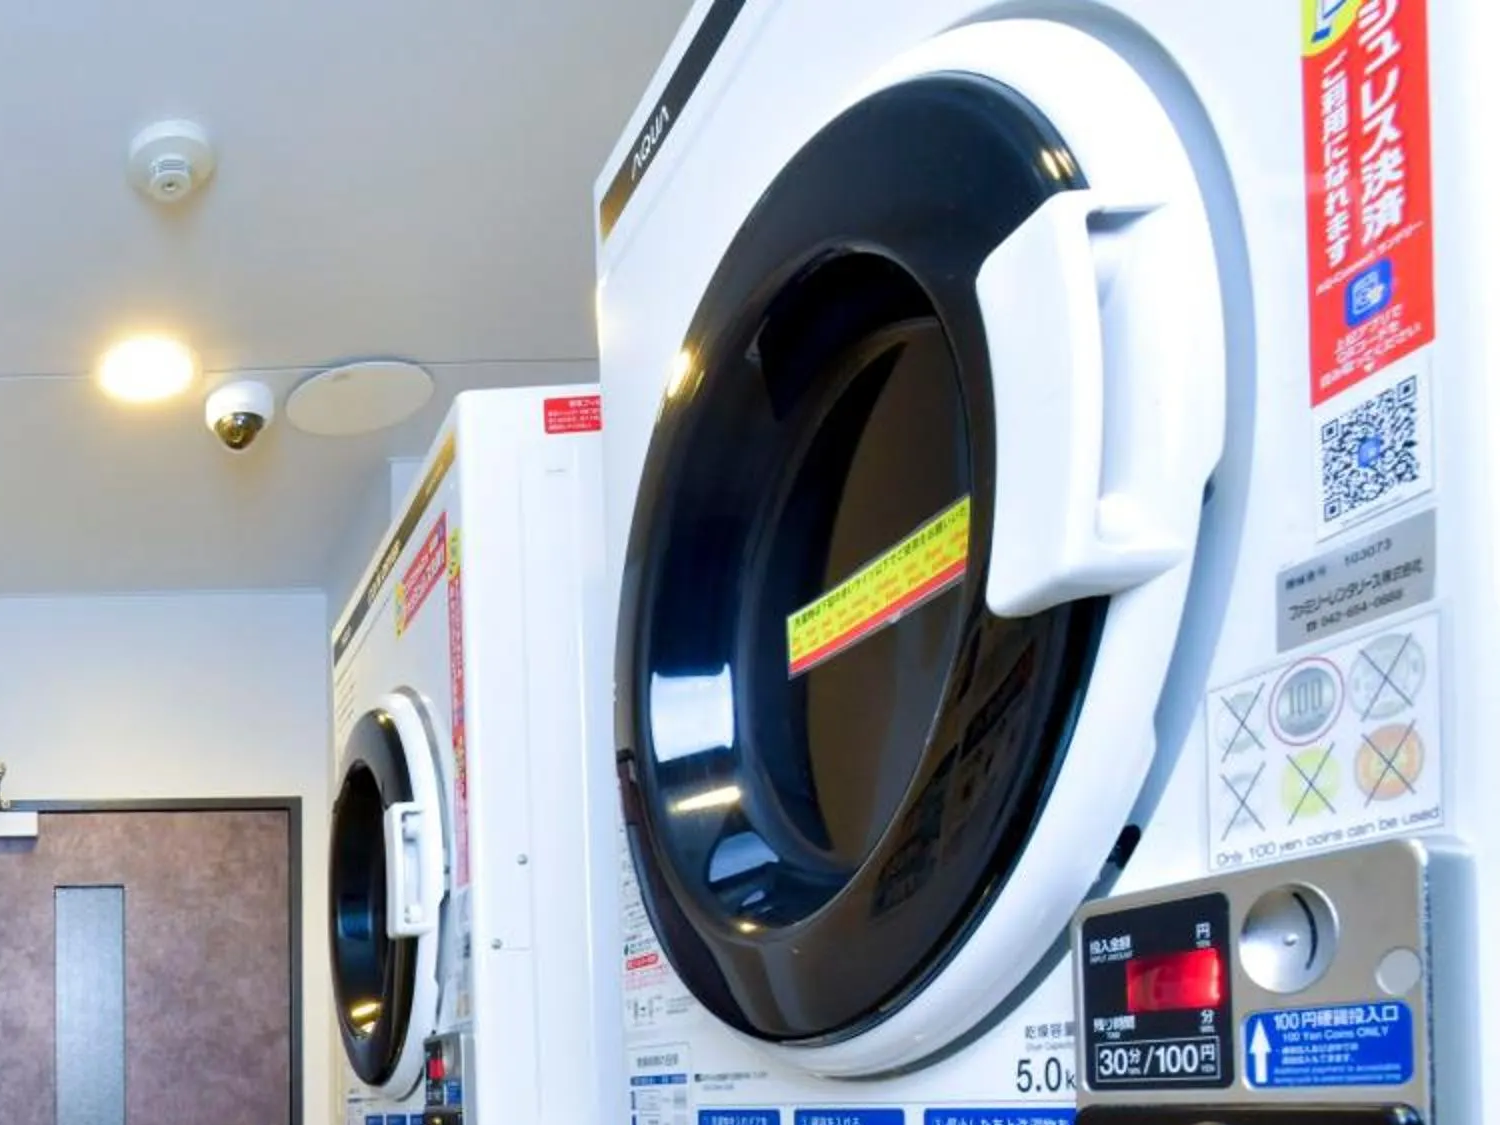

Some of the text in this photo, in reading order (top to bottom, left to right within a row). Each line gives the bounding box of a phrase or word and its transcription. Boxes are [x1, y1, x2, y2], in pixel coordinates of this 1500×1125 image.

[1250, 841, 1277, 859] 100
[1279, 838, 1303, 855] yen
[1306, 830, 1343, 847] coins
[1347, 822, 1375, 838] can
[1378, 814, 1398, 831] be
[1402, 806, 1440, 826] used
[1196, 922, 1211, 939] 円
[1201, 1009, 1215, 1024] 分
[1274, 1005, 1399, 1031] 100円硬貨投入口
[1356, 1026, 1390, 1038] ONLY
